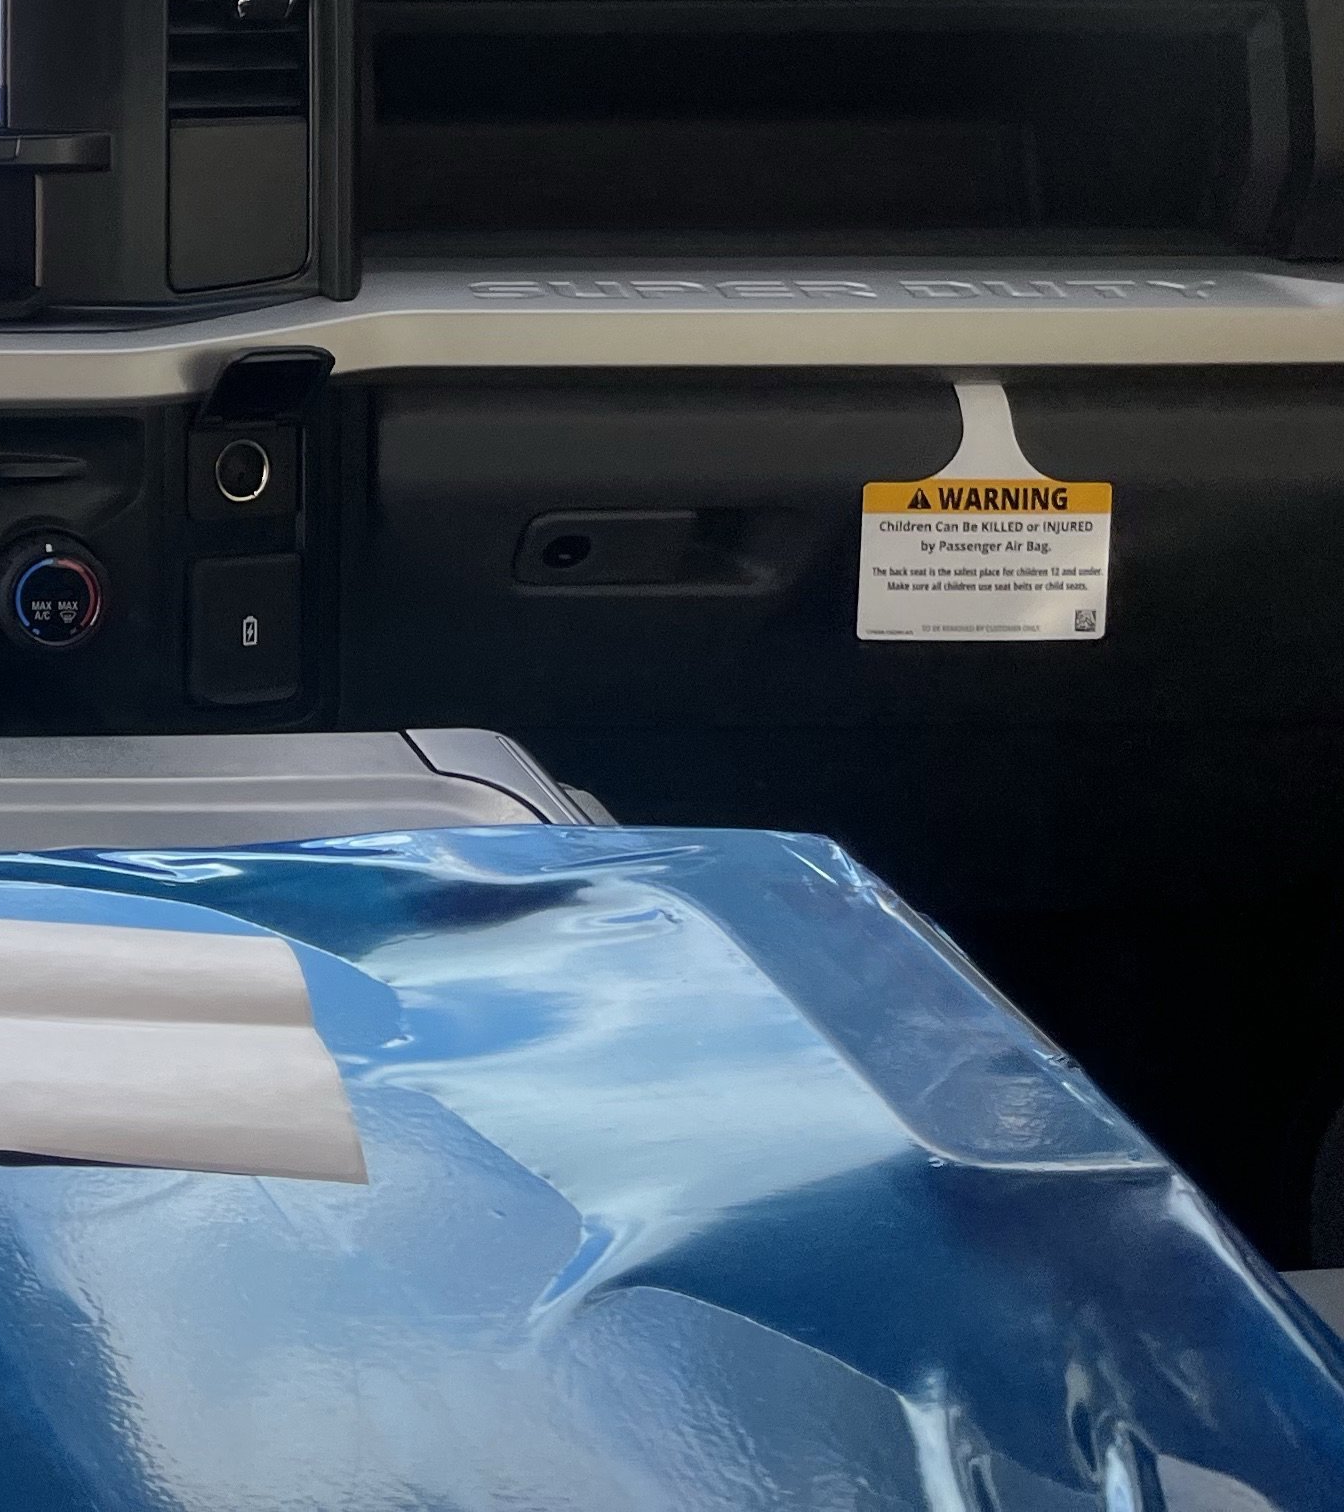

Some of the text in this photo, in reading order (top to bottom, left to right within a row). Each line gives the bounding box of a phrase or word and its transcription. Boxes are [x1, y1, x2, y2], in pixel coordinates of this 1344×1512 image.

[468, 280, 1217, 300] SUPER DUTY
[938, 487, 1069, 510] WARNING
[879, 521, 1093, 535] Children Can Be KILLED or INJURED
[920, 541, 1052, 555] by Passenger Air Bag.
[872, 567, 887, 576] The
[889, 567, 908, 576] back
[910, 567, 927, 576] seat
[929, 567, 936, 576] is
[938, 567, 951, 576] the
[979, 567, 1000, 579] place
[1002, 567, 1014, 576] for
[1016, 567, 1048, 576] children
[1051, 567, 1060, 576] 12
[1062, 567, 1077, 576] and
[887, 581, 910, 591] Make
[912, 581, 929, 591] sure
[931, 581, 942, 591] all
[944, 581, 976, 591] children
[978, 581, 993, 591] use
[994, 581, 1011, 591] seat
[1013, 581, 1033, 591] belts
[1045, 581, 1064, 591] child
[31, 601, 52, 611] MAX
[58, 601, 79, 611] MAX
[34, 610, 51, 621] A/C
